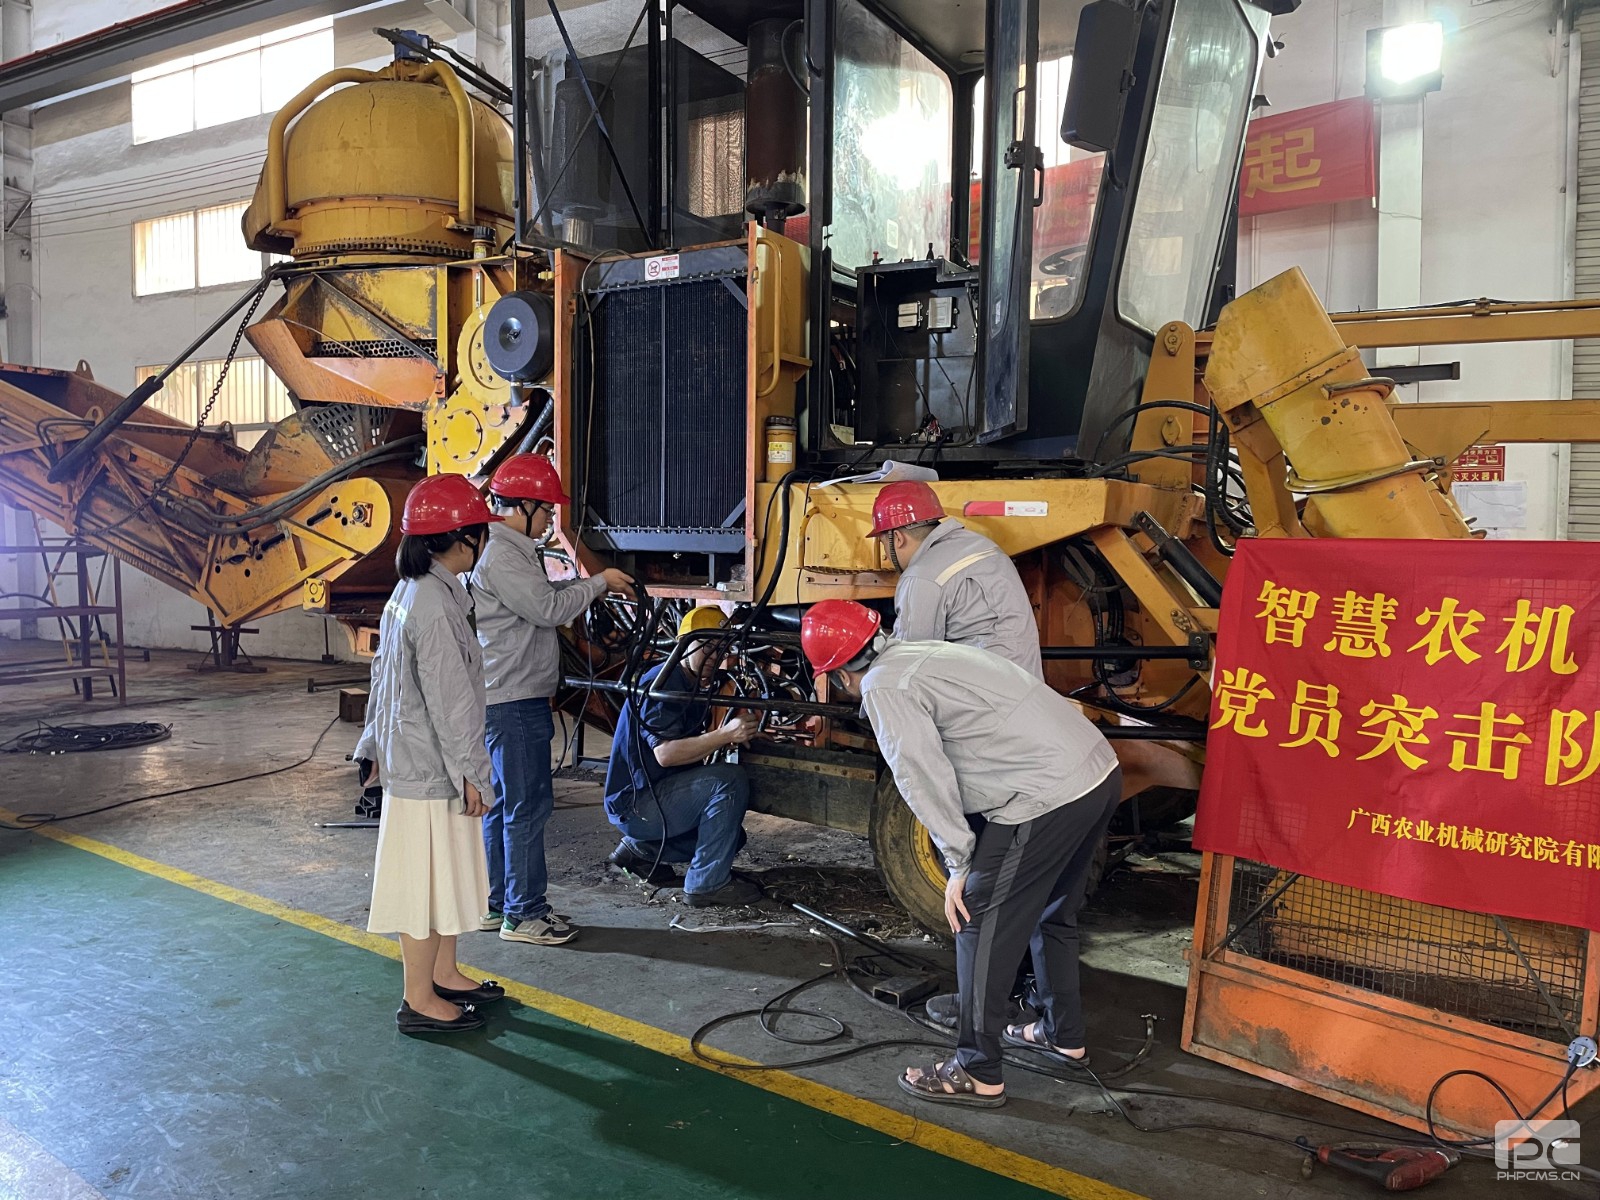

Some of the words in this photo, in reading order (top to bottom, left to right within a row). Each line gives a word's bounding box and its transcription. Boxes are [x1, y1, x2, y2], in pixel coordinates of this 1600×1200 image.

[1244, 127, 1323, 198] 起
[1461, 472, 1489, 481] 灭火器
[1254, 579, 1579, 675] 智慧农机
[1209, 666, 1600, 787] 党员突击队
